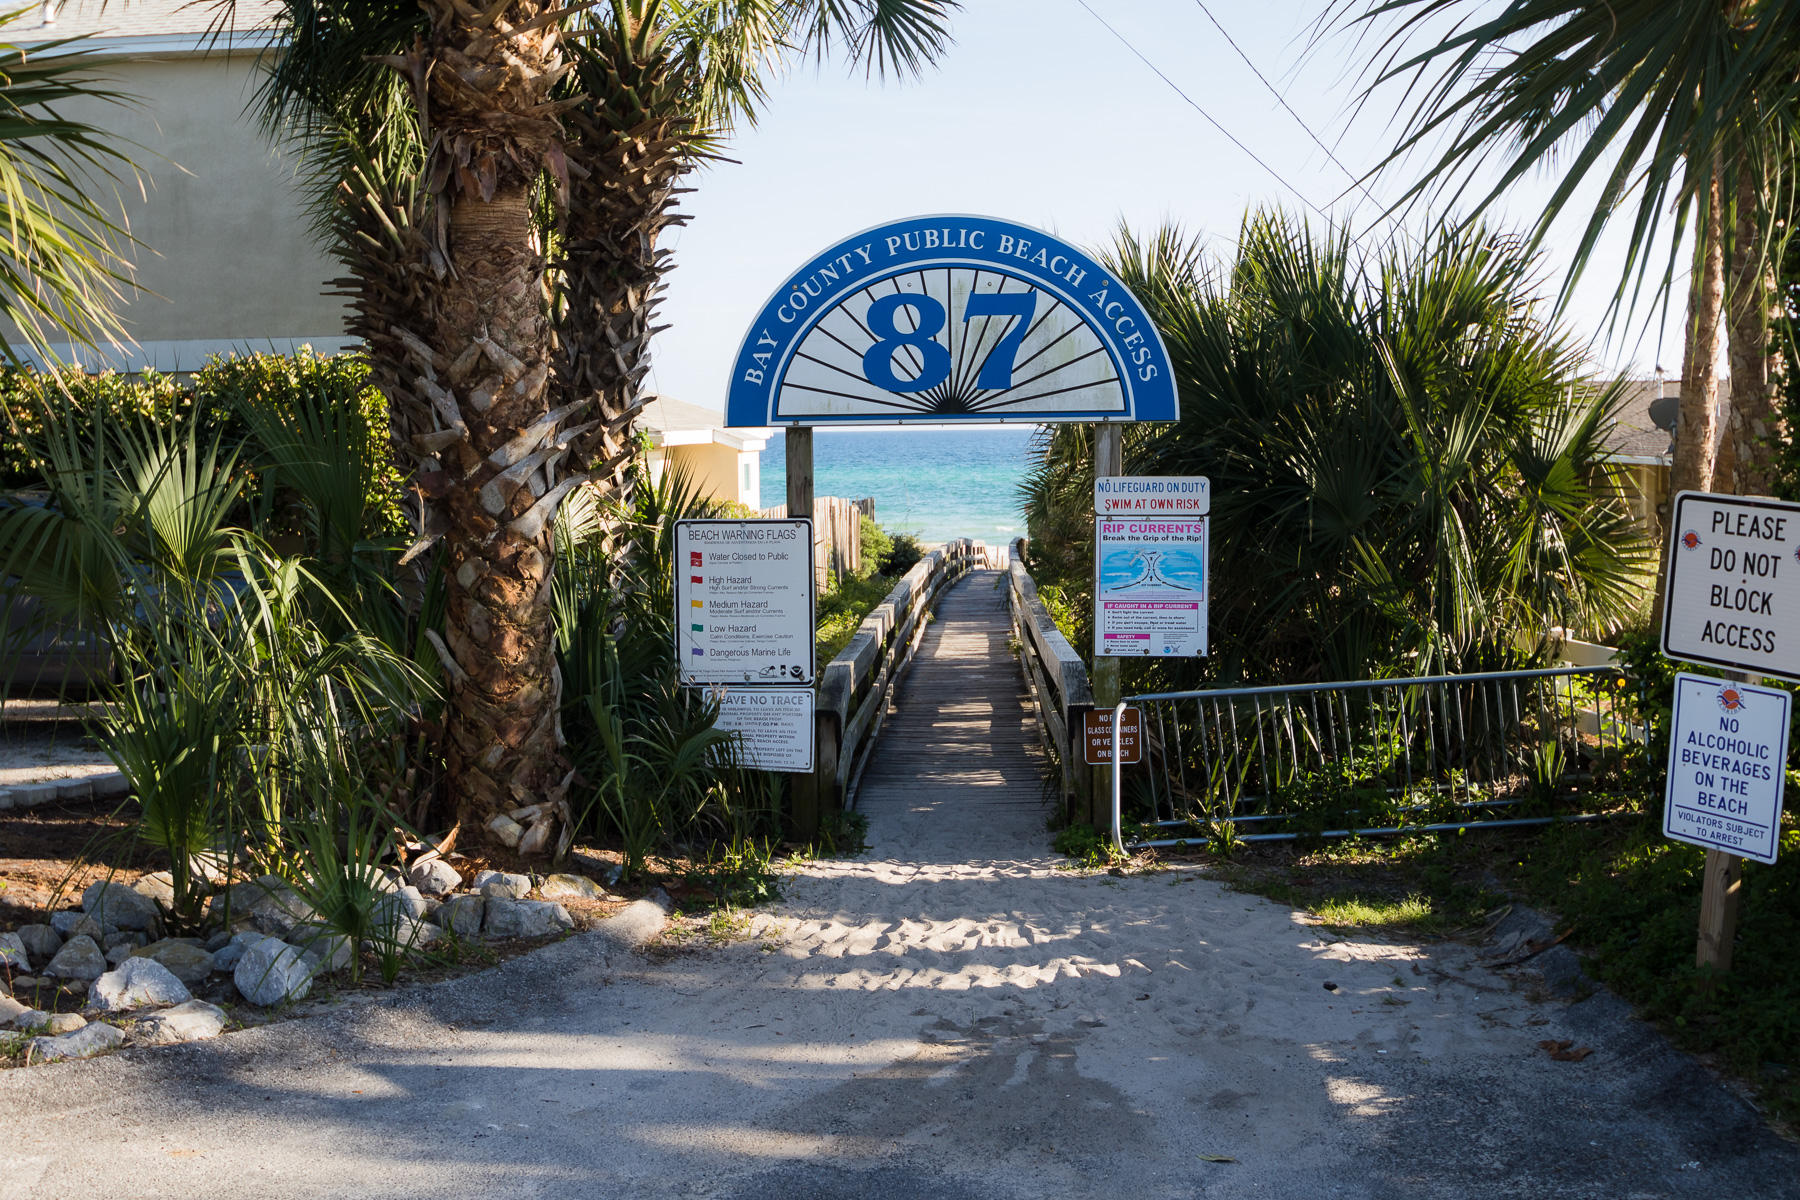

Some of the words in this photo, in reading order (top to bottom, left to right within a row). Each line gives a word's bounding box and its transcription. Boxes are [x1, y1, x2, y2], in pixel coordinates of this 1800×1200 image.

[744, 328, 778, 386] BAY
[777, 244, 873, 324] COUNTY
[885, 228, 985, 256] PUBLIC
[997, 233, 1088, 288] BEACH
[1088, 289, 1158, 382] ACCESS
[862, 286, 1037, 393] 87
[1098, 482, 1111, 493] NO
[1113, 482, 1165, 493] LIFEGUARD
[1166, 482, 1180, 493] ON
[1181, 482, 1206, 493] DUTY
[1105, 499, 1132, 510] SWIM
[1134, 499, 1147, 509] AT
[1150, 499, 1174, 509] OWN
[1176, 499, 1200, 509] RISK
[1103, 524, 1125, 534] RIP
[1129, 524, 1202, 534] CURRENTS
[1712, 510, 1787, 541] PLEASE
[688, 529, 720, 541] BEACH
[721, 529, 764, 541] WARNING
[766, 529, 797, 540] FLAGS
[1103, 534, 1126, 542] Break
[1128, 534, 1140, 542] the
[1142, 535, 1159, 543] Grip
[1162, 534, 1170, 542] of
[1171, 534, 1184, 542] the
[709, 552, 730, 561] Water
[732, 552, 757, 561] Closed
[758, 552, 766, 561] to
[767, 552, 789, 561] Public
[1710, 548, 1736, 572] DO
[1743, 552, 1782, 579] NOT
[709, 576, 725, 586] High
[726, 576, 752, 584] Hazard
[709, 600, 739, 608] Medium
[740, 600, 768, 608] Hazard
[1710, 584, 1773, 616] BLOCK
[709, 624, 726, 633] Low
[728, 624, 757, 633] Hazard
[1701, 620, 1776, 654] ACCESS
[710, 648, 750, 658] Dangerous
[751, 648, 776, 656] Marine
[777, 647, 791, 656] Life
[720, 695, 746, 705] EAVE
[750, 695, 767, 705] NO
[770, 695, 804, 705] TRACE
[1099, 714, 1109, 723] NO
[1087, 726, 1105, 734] GLASS
[1719, 716, 1739, 733] NO
[1091, 738, 1102, 746] OR
[1687, 730, 1769, 760] ALCOHOLIC
[1097, 750, 1107, 758] ON
[1107, 749, 1129, 758] BCH
[1681, 749, 1771, 781] BEVERAGES
[1695, 771, 1714, 788] ON
[1721, 776, 1749, 796] THE
[1697, 791, 1748, 816] BEACH
[1678, 811, 1723, 829] VIOLATORS
[1726, 823, 1765, 840] SUBJECT
[1696, 827, 1707, 837] TO
[1709, 831, 1744, 846] ARREST
